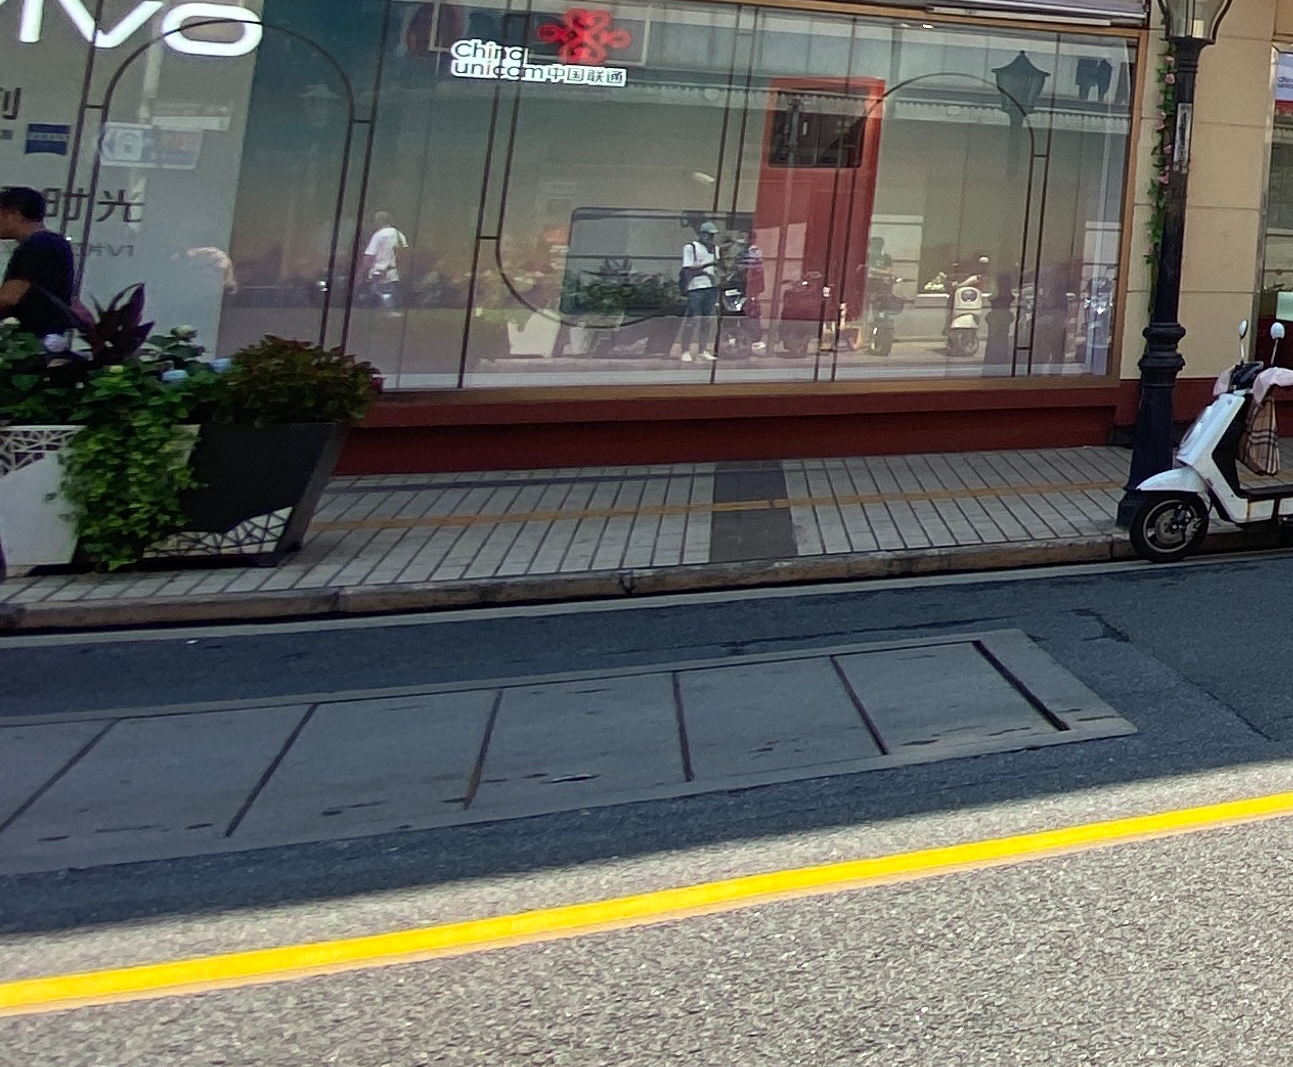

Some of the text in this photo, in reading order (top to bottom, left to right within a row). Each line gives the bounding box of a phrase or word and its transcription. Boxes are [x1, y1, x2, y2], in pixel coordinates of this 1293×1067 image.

[453, 40, 528, 64] China
[453, 60, 625, 85] unicom 中国联通
